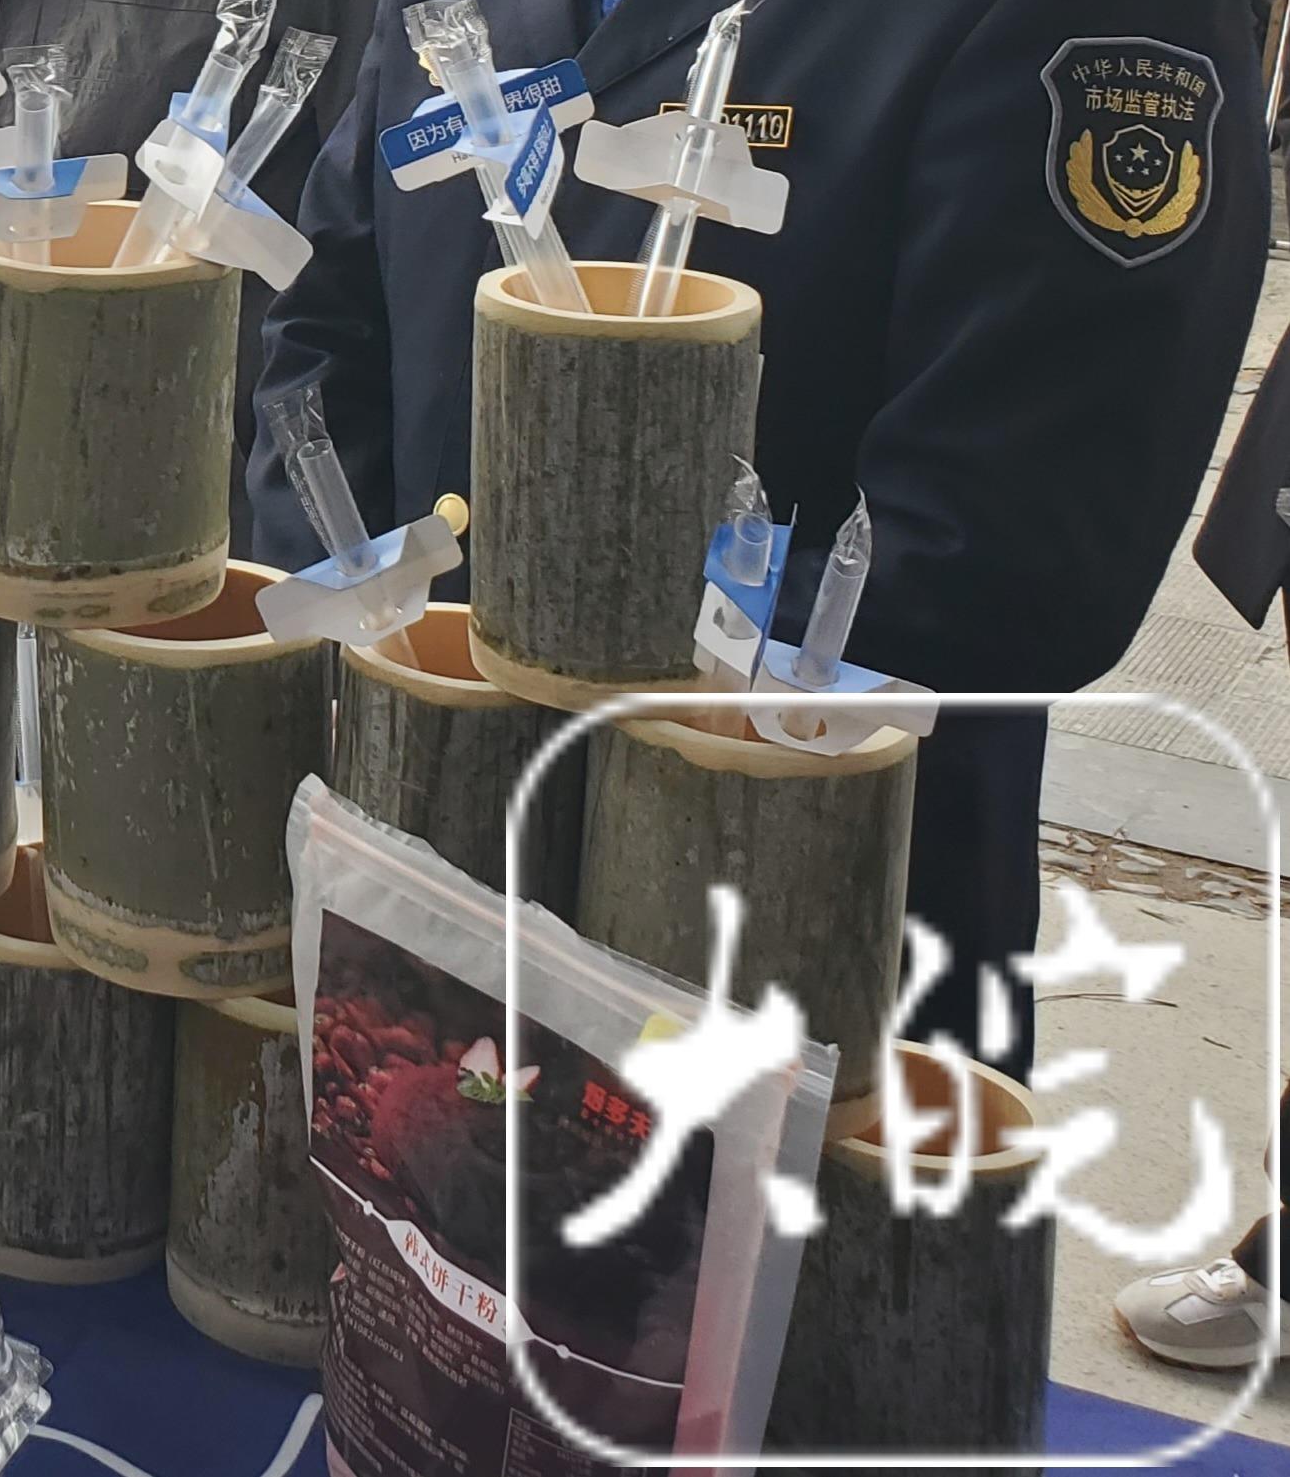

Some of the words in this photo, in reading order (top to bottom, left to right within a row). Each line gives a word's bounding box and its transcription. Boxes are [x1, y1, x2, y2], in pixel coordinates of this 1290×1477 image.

[1071, 57, 1207, 99] 中华人民共和国
[1085, 84, 1196, 121] 市场监管执法
[406, 114, 467, 152] 因为有
